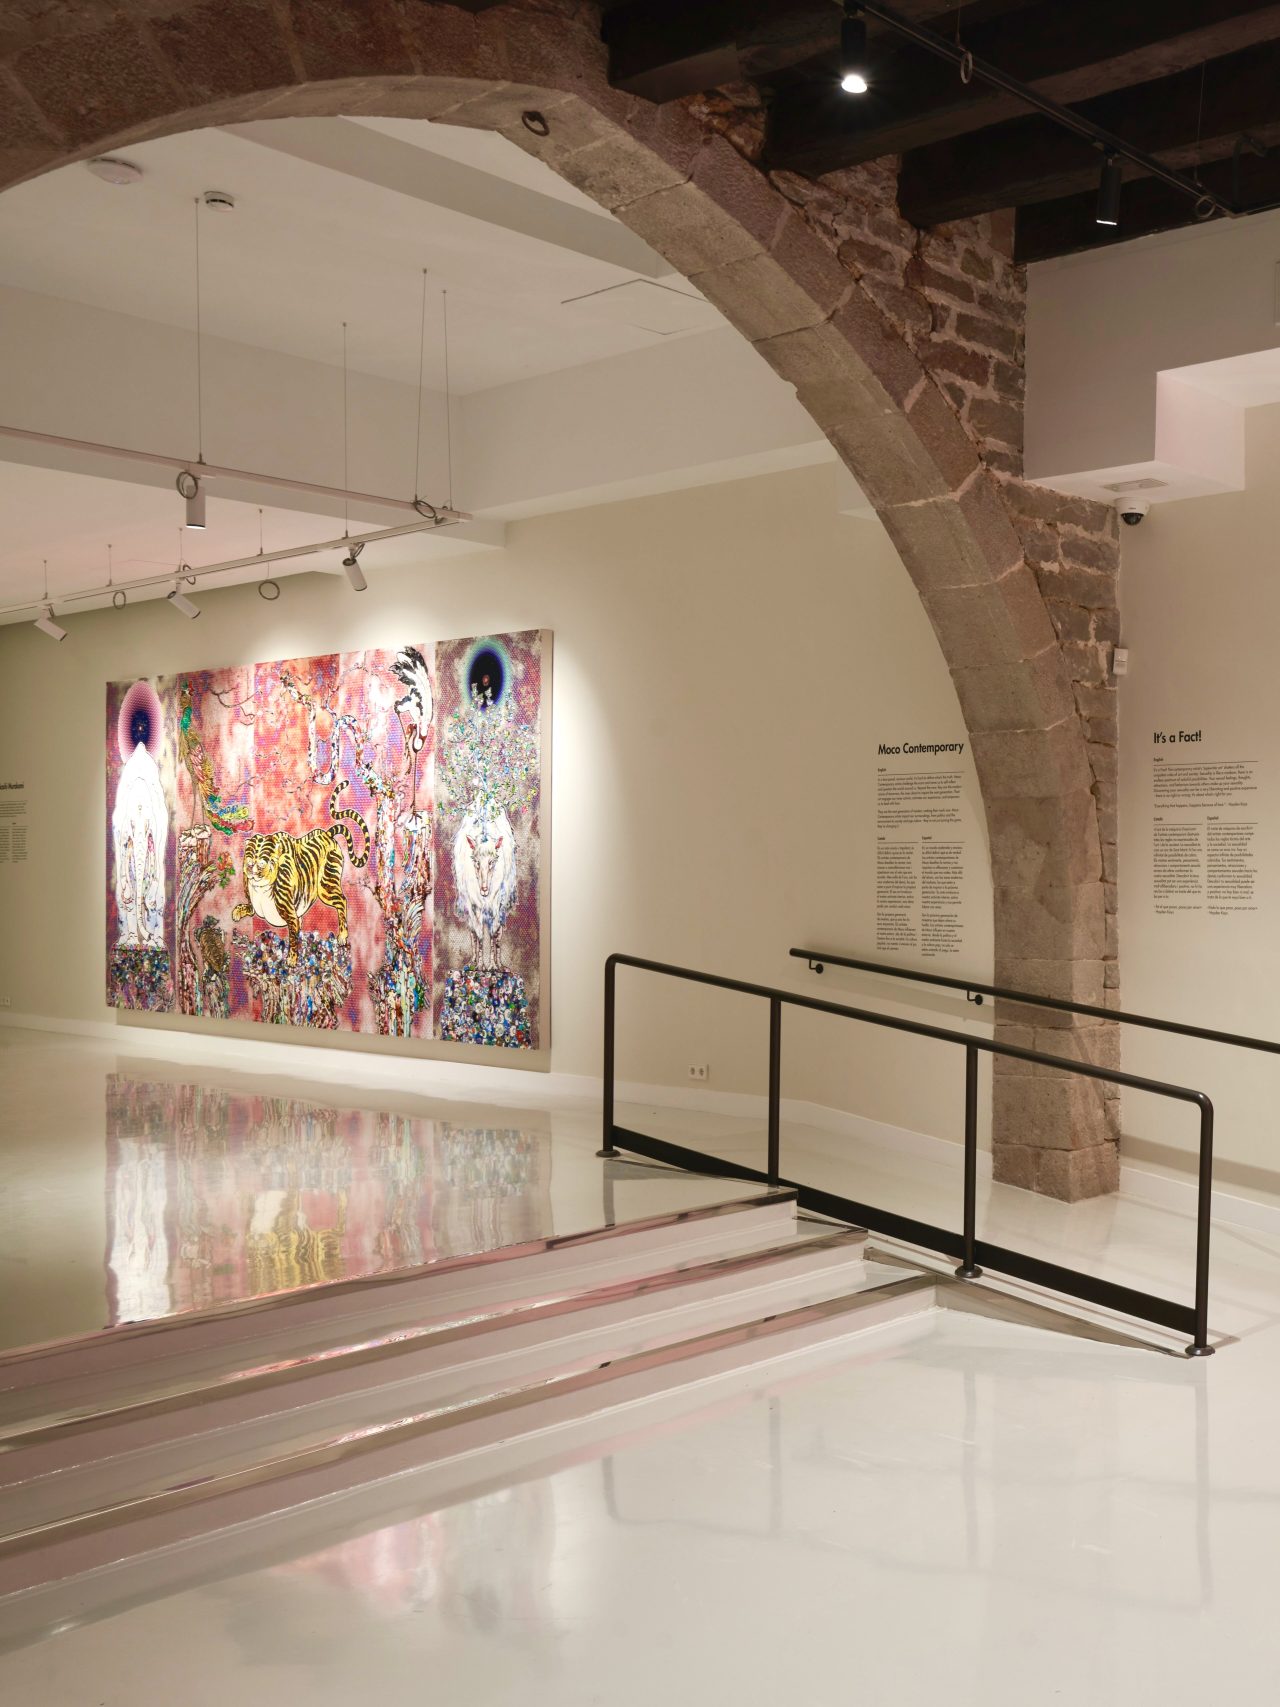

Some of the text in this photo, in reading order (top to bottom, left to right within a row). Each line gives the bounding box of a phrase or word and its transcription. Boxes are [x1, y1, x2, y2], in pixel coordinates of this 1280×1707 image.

[1153, 730, 1202, 744] It's a Fact!
[878, 743, 965, 756] Moco Contemporary
